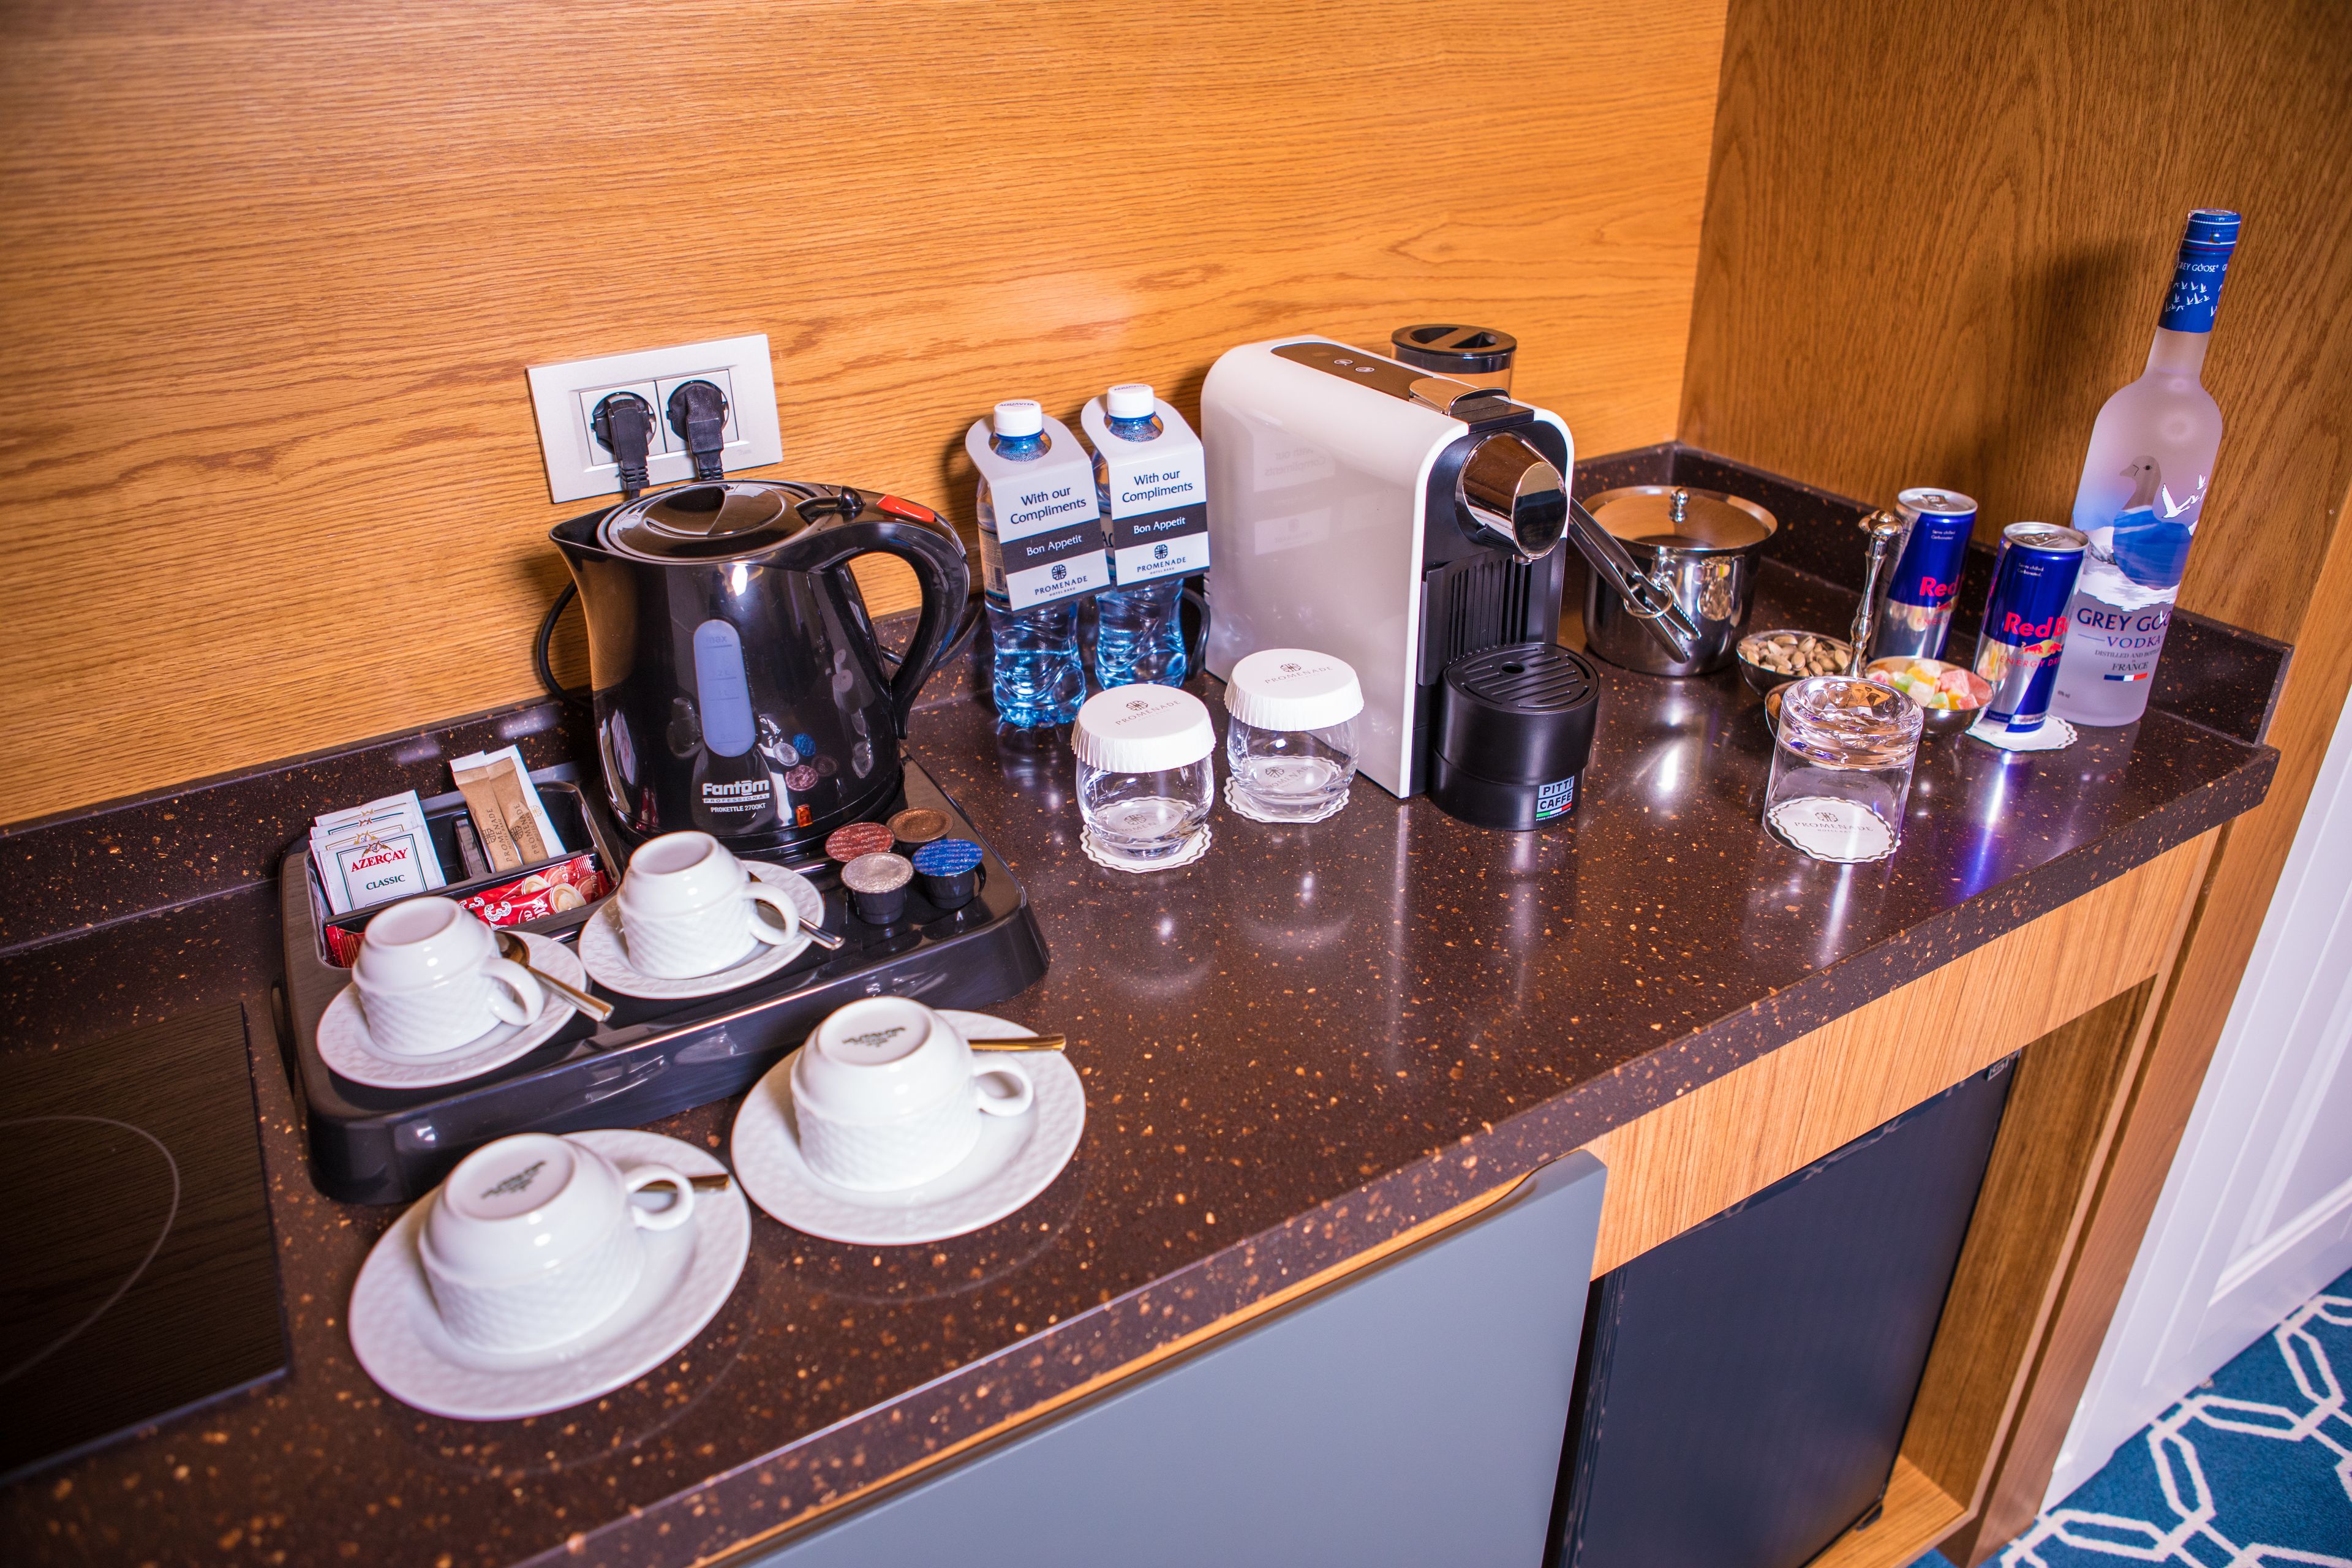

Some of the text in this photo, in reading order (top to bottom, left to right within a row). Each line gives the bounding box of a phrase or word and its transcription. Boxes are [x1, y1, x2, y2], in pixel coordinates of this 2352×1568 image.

[1134, 470, 1180, 486] With our
[1020, 487, 1071, 506] With our
[1122, 482, 1193, 502] Compliments
[1010, 499, 1087, 524] Compliments
[1133, 516, 1186, 534] Bon Appetit
[1026, 534, 1082, 556] Bon Appetit
[1137, 557, 1186, 573] PROMENADE
[1035, 576, 1088, 595] PROMENADE
[1920, 574, 1960, 597] Red
[2003, 611, 2054, 638] Red
[2077, 608, 2133, 631] GREY
[2107, 635, 2161, 649] VODKA
[1999, 656, 2045, 668] ENERGY
[2095, 649, 2130, 658] DISTILLED
[1265, 666, 1333, 684] PROMENADE
[2112, 662, 2149, 672] FRANCE
[1115, 700, 1181, 725] PROMENADE
[1543, 778, 1572, 796] PITTI
[704, 794, 768, 803] PROFESSIONAL
[745, 802, 766, 811] 2700KT
[486, 809, 512, 862] PROMENADE
[514, 803, 539, 854] PROMENADE
[1793, 821, 1874, 832] PROMENADE
[351, 849, 407, 872] AZERÇAY
[366, 875, 405, 890] CLASSIC
